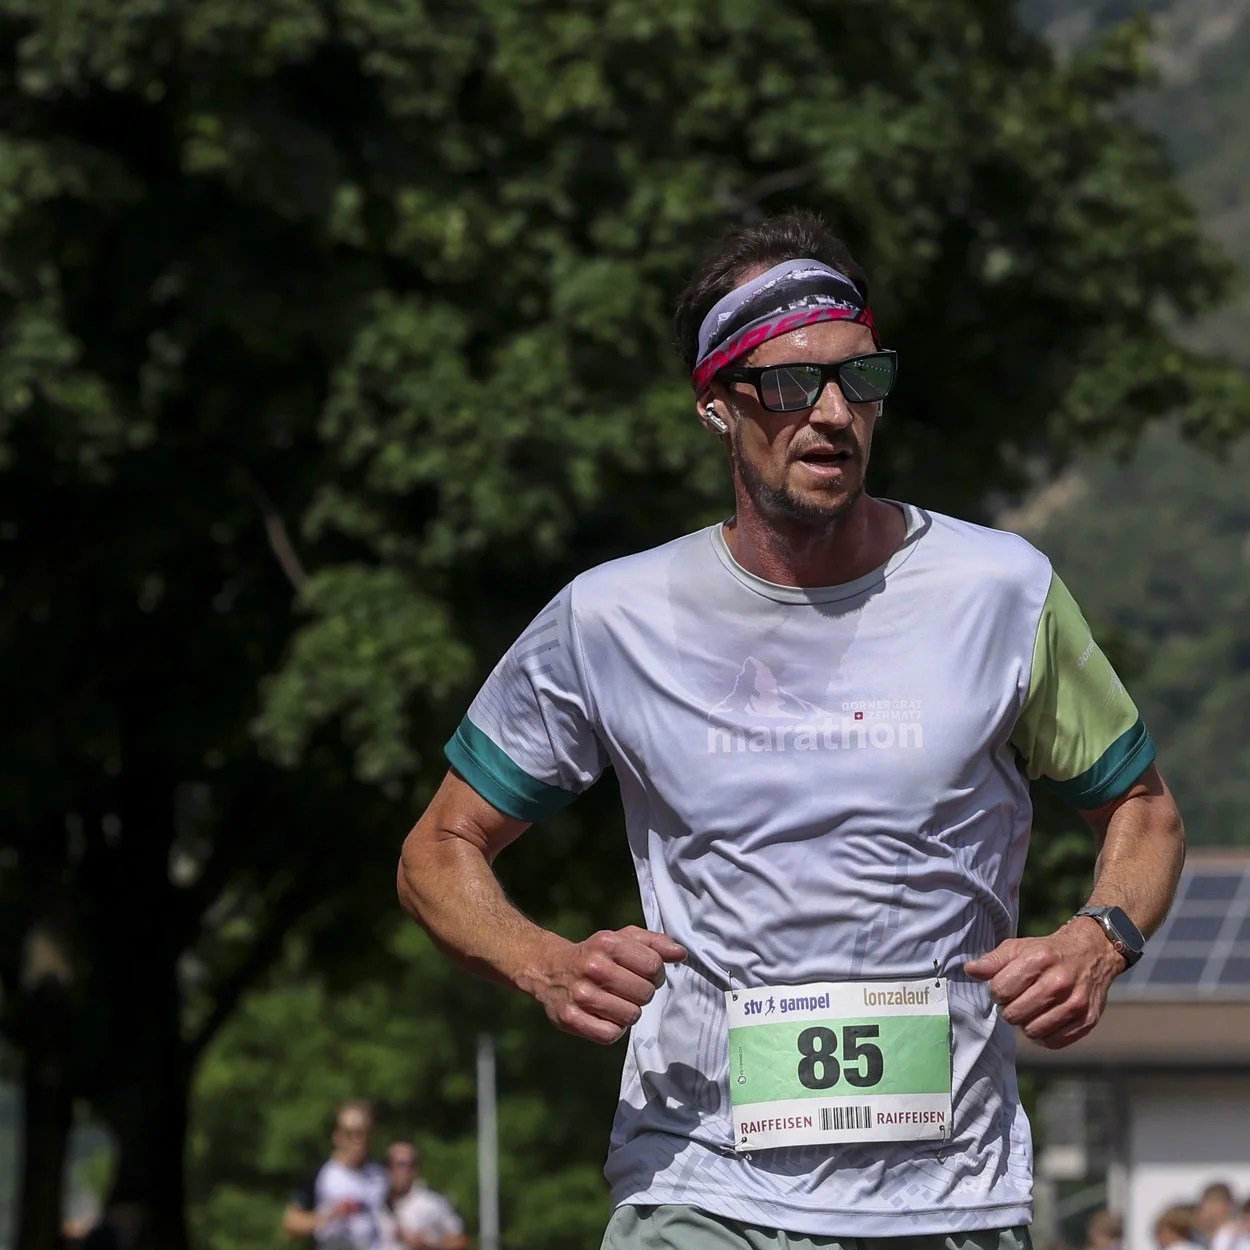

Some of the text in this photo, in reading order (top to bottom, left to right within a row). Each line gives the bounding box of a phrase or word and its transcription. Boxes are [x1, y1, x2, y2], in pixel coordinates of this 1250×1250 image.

[841, 700, 922, 711] GORNERGRAT
[867, 710, 922, 721] ZERMATT
[707, 717, 924, 753] marathon
[744, 993, 830, 1015] stv gampel
[863, 986, 930, 1006] lonzalauf
[797, 1024, 884, 1090] 85
[741, 1116, 812, 1134] RAIFFEISEN
[876, 1111, 945, 1125] RAIFFEISEN
